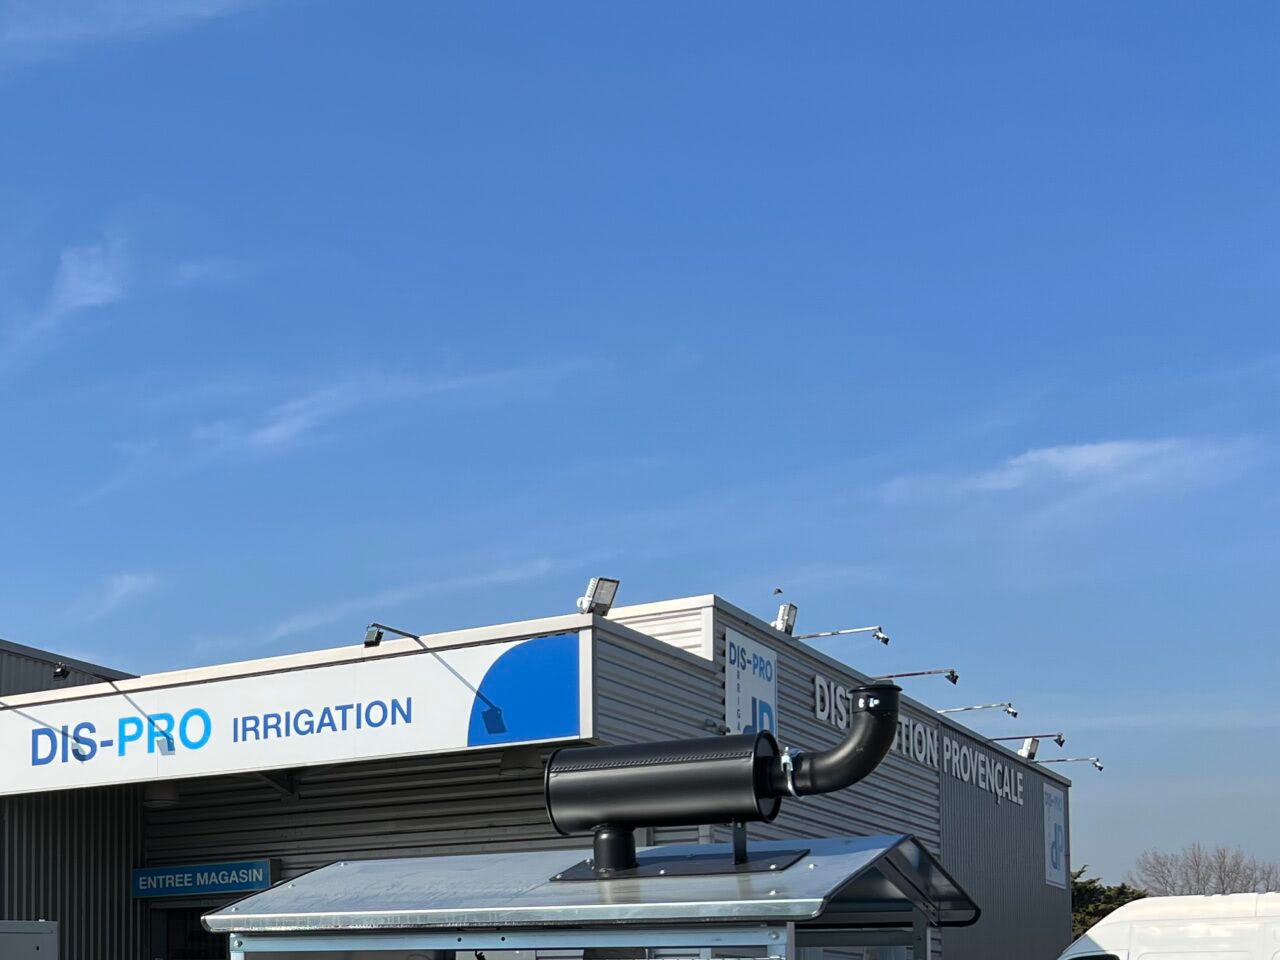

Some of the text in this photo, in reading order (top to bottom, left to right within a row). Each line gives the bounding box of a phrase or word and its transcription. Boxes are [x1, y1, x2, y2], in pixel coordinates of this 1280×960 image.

[728, 641, 773, 682] DIS-PRO
[31, 697, 413, 766] DIS-PRO IRRIGATION
[943, 736, 1024, 806] PROVENÇALE
[139, 868, 263, 890] ENTREE MAGASIN
